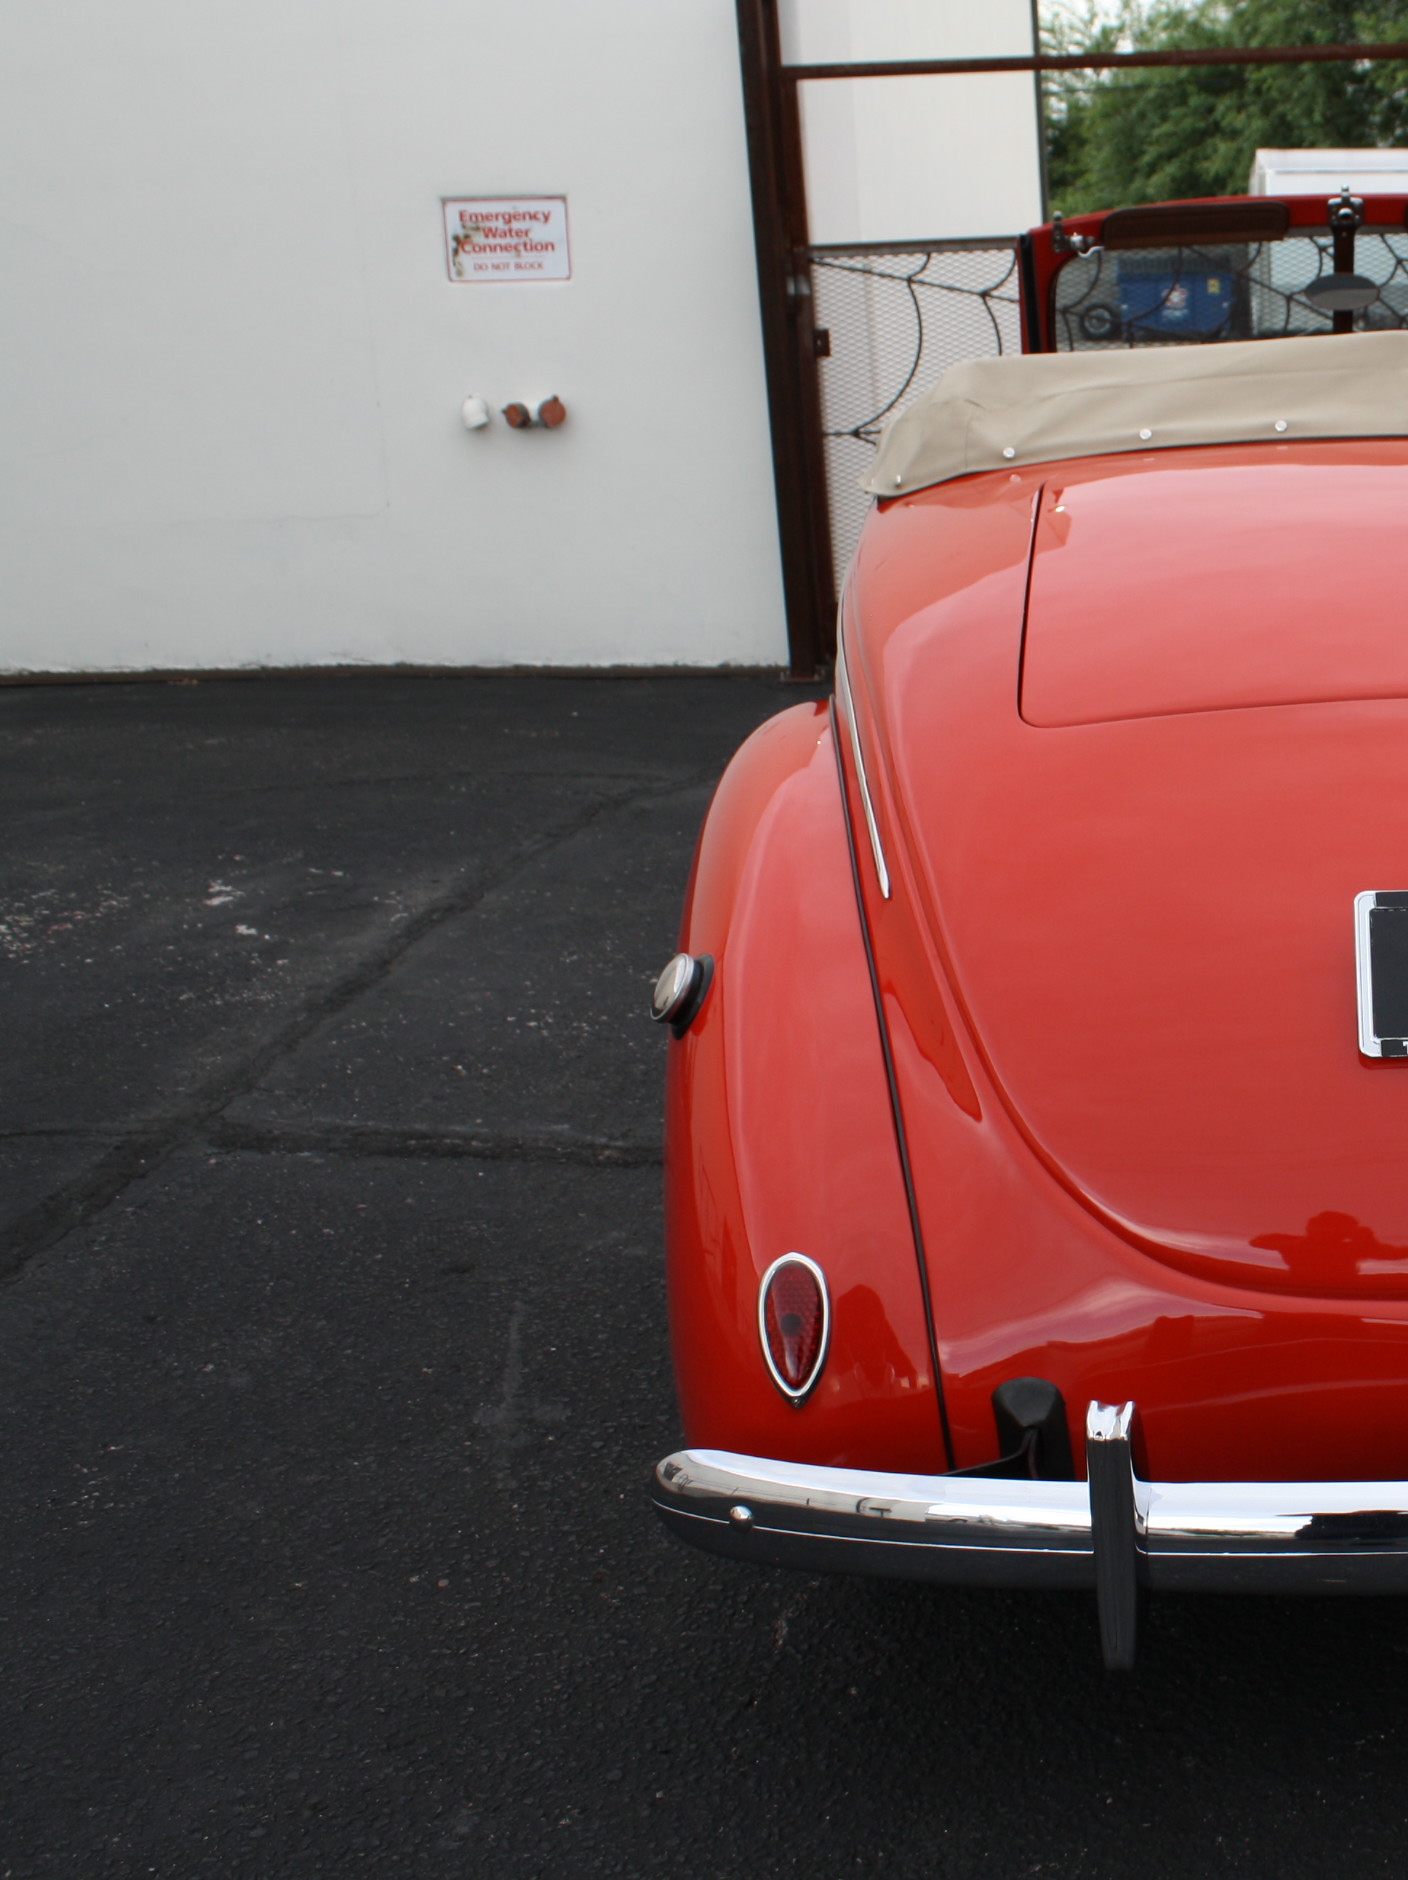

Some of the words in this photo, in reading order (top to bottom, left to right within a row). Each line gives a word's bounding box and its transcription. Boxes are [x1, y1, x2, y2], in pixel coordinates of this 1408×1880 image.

[459, 210, 551, 225] Emergency
[482, 226, 532, 239] Water
[460, 239, 555, 254] Connection
[473, 262, 488, 271] DO
[491, 261, 510, 271] NOT
[514, 261, 544, 270] BLOCK
